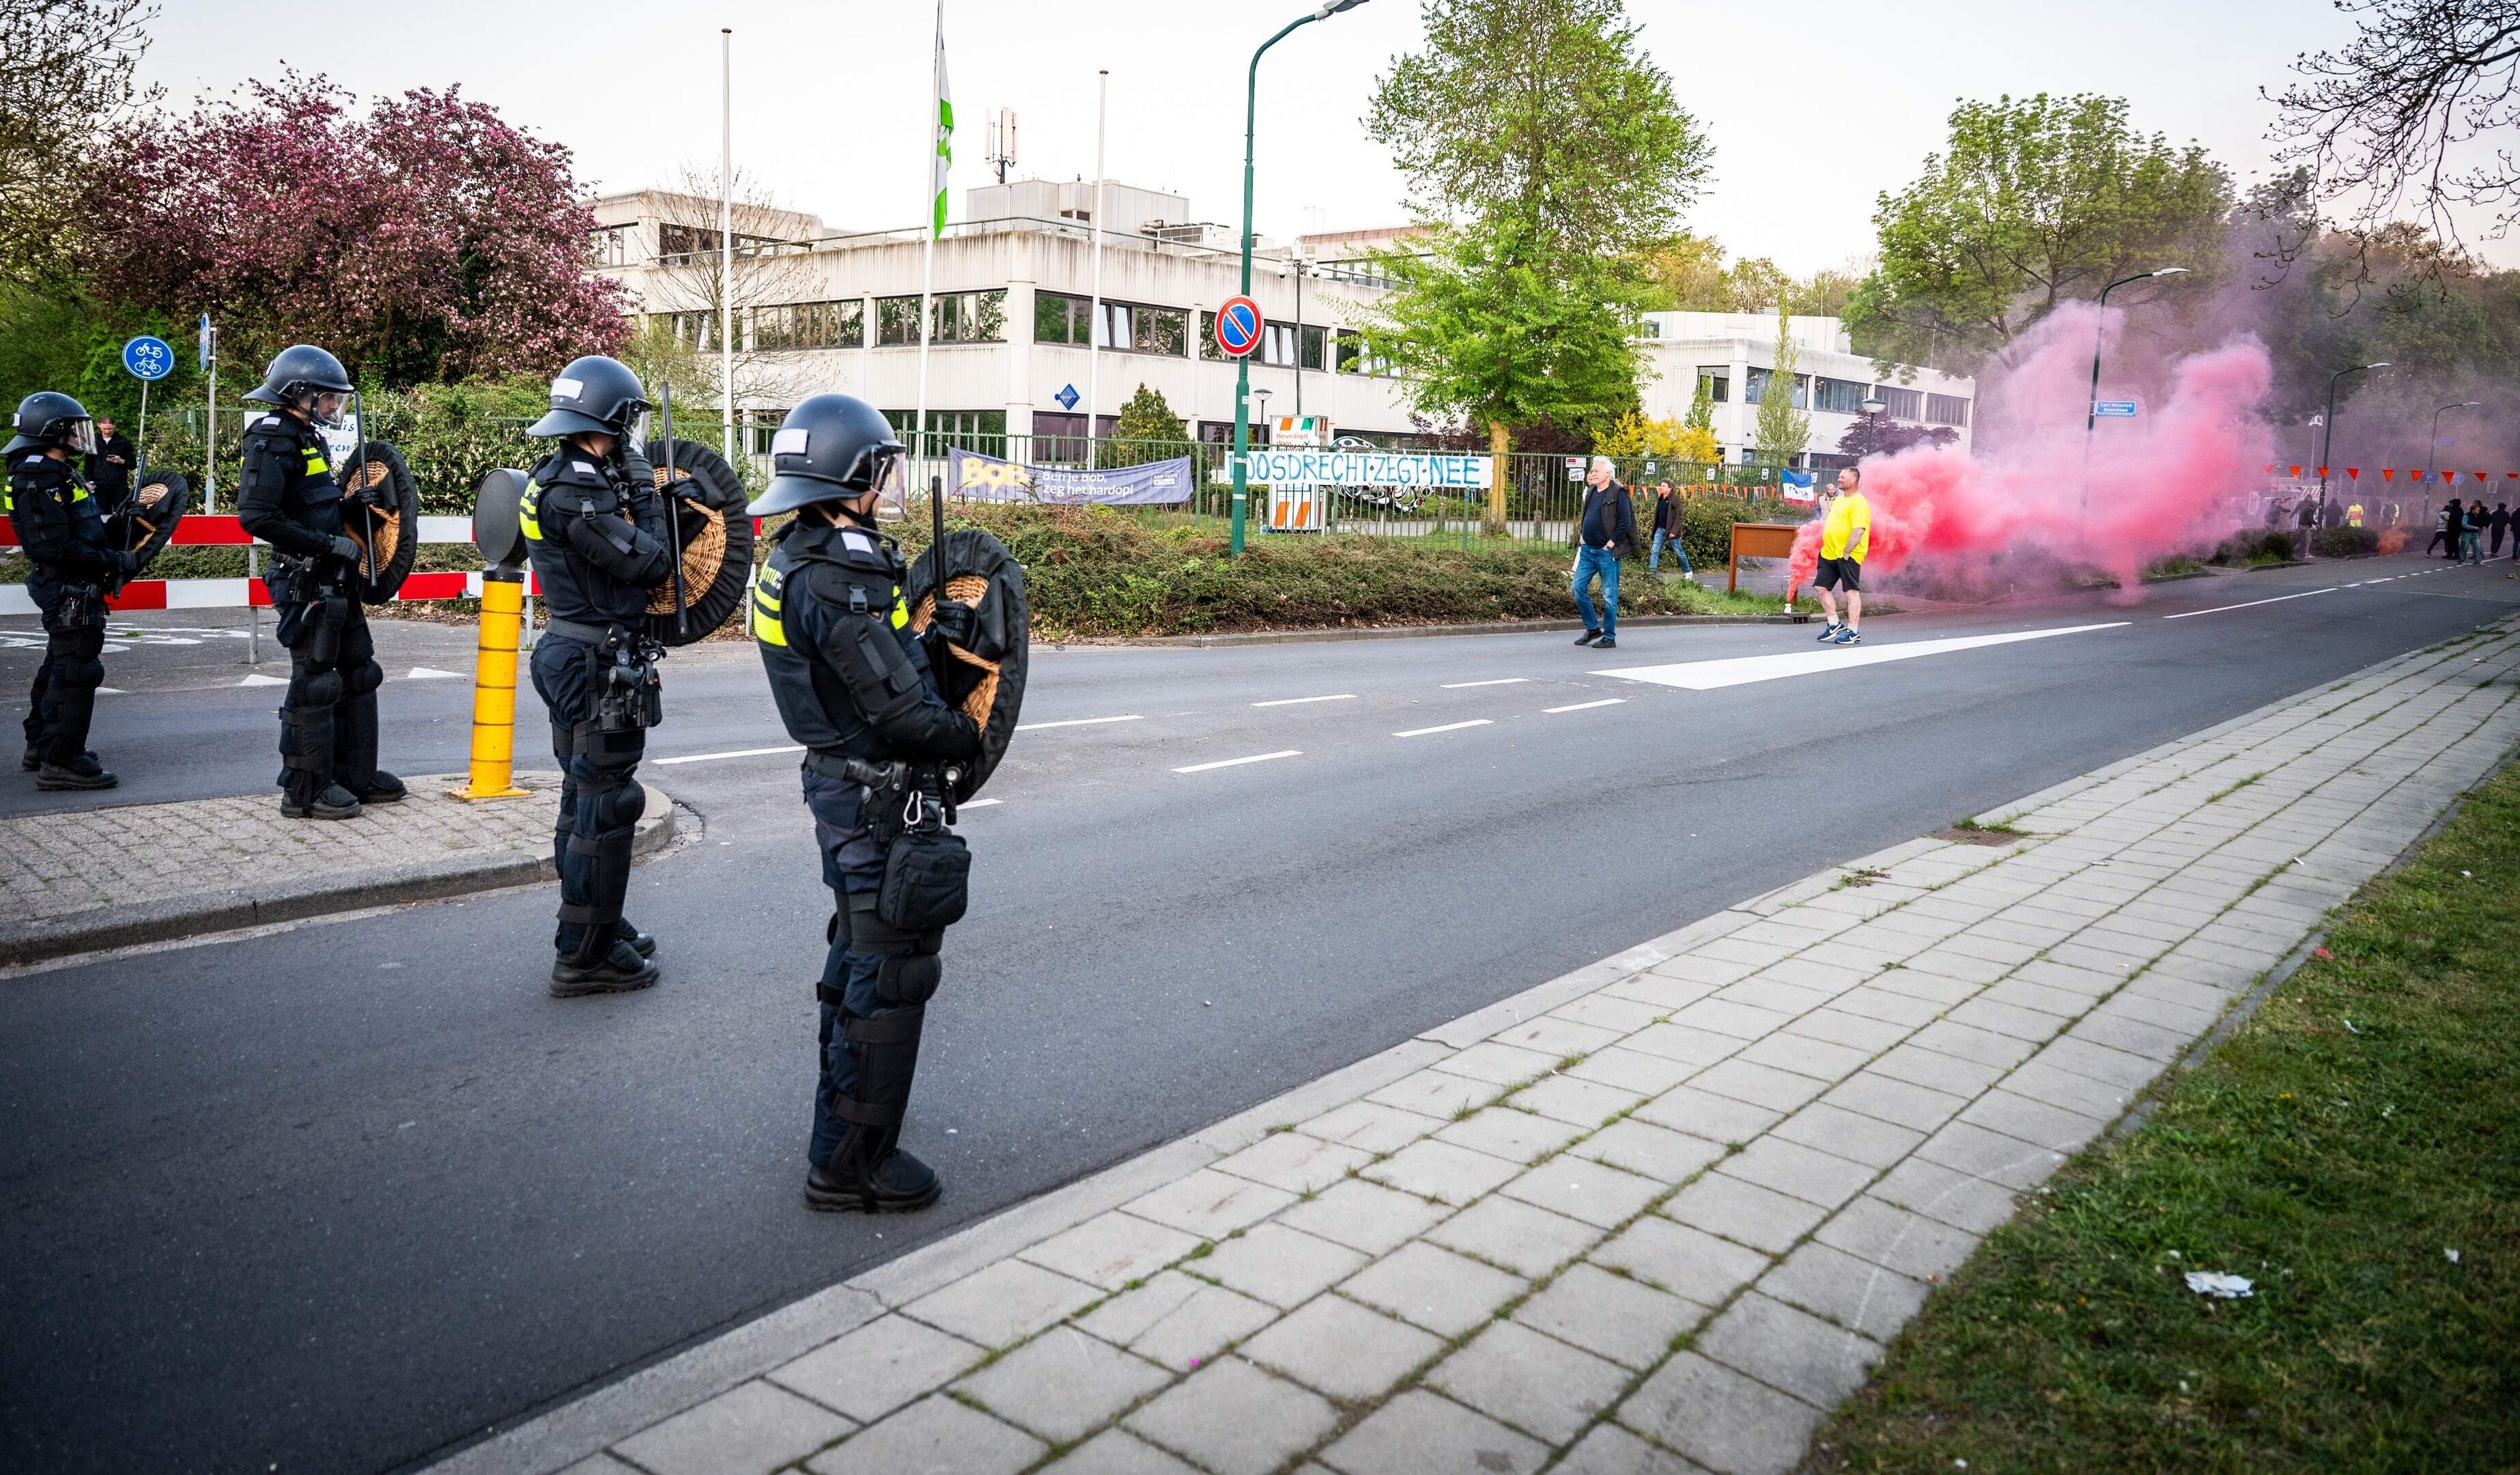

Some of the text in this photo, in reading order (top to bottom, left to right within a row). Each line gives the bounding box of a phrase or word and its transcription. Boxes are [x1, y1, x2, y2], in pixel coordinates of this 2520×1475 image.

[1374, 455, 1424, 483] ZEGT
[1430, 456, 1480, 485] NEE
[1043, 471, 1107, 483] Ben je Bob,
[1043, 484, 1065, 496] zeg
[1067, 484, 1087, 495] het
